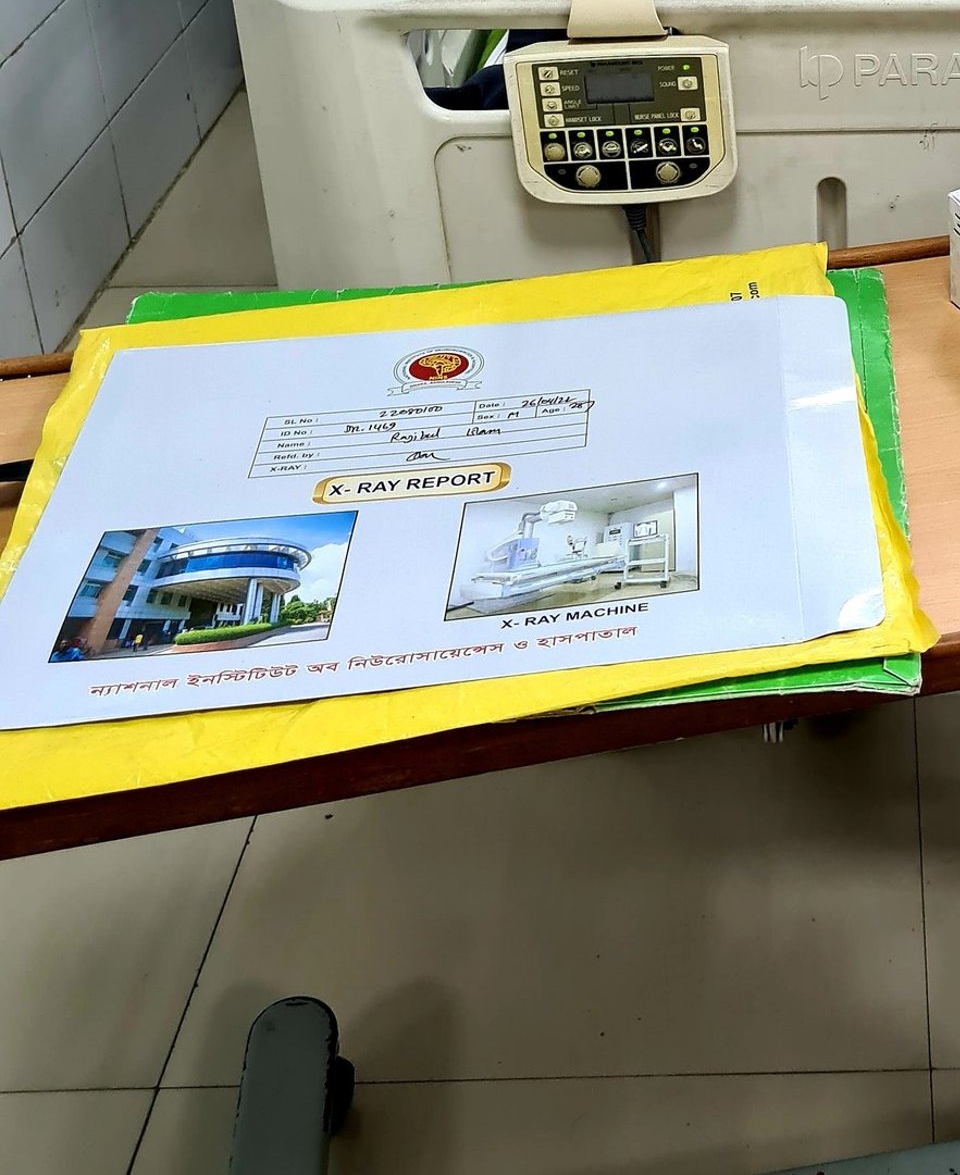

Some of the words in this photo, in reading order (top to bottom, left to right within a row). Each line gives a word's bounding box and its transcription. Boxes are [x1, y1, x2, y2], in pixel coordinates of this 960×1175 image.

[651, 112, 666, 120] PANEL
[270, 464, 302, 472] X-RAY
[357, 479, 401, 494] RAY
[406, 471, 496, 490] REPORT
[524, 613, 560, 626] RAY
[566, 602, 649, 622] MACHINE
[90, 676, 178, 696] ন্যাশনাল
[186, 664, 299, 687] ইনস্টিটিউট
[306, 660, 339, 674] অব
[513, 639, 529, 650] ও
[536, 626, 637, 649] হাসপাতাল
